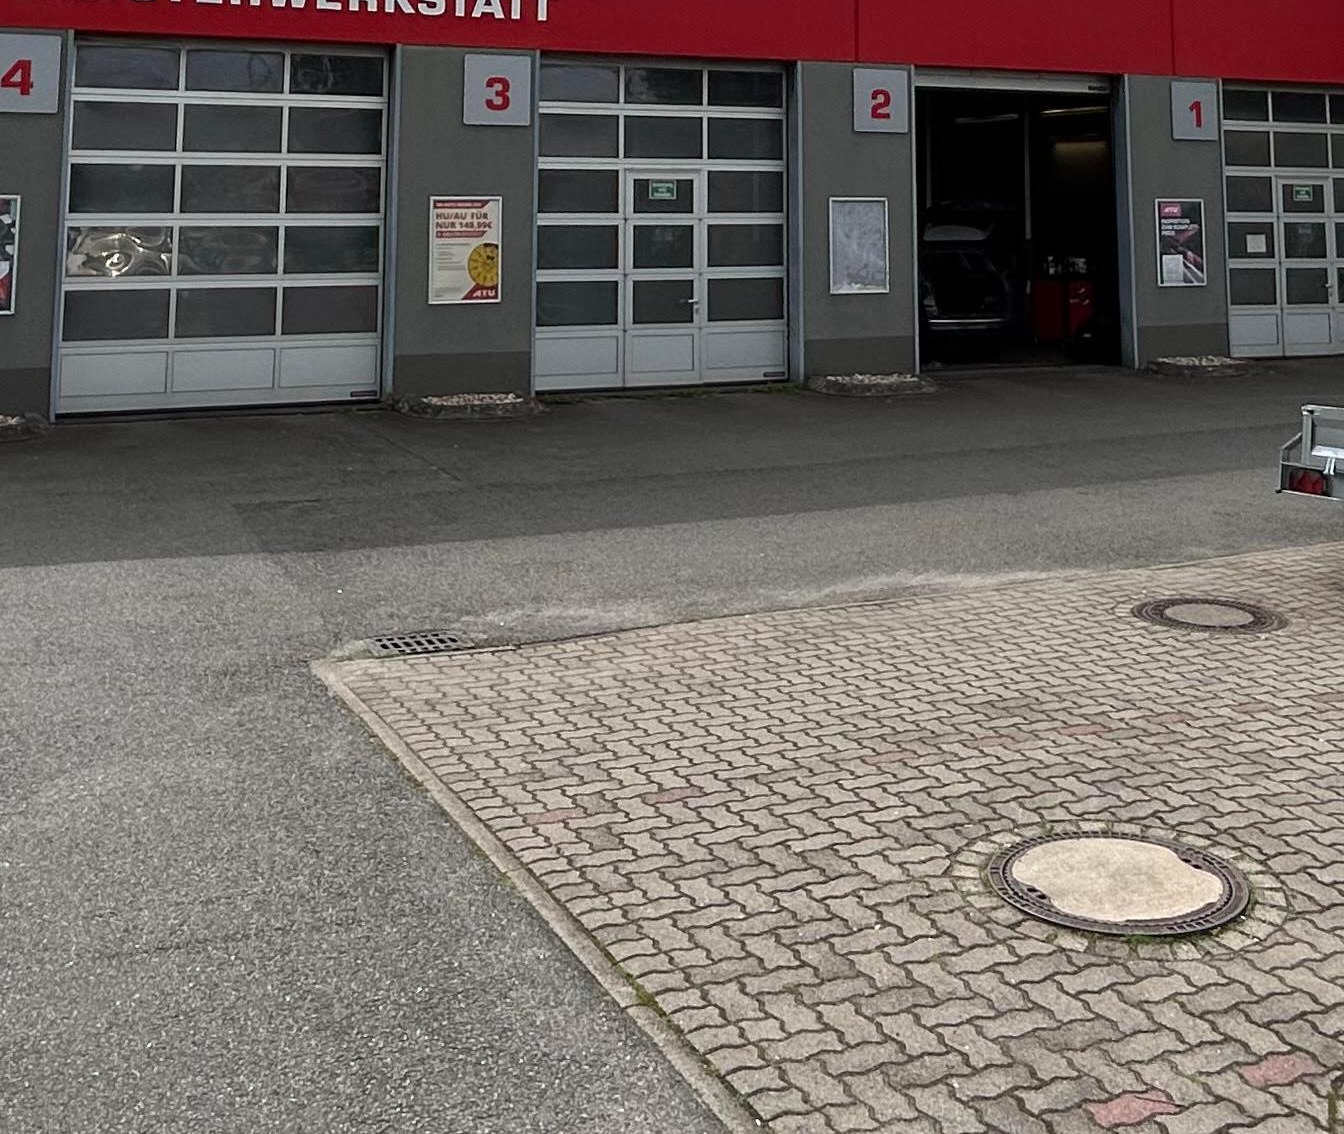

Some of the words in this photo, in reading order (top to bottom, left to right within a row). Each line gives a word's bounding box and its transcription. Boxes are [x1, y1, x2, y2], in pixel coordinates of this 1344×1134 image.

[0, 59, 34, 97] 4
[485, 76, 511, 112] 3
[870, 88, 892, 120] 2
[1188, 100, 1203, 129] 1
[436, 221, 457, 229] NUR
[472, 288, 496, 298] ATU
